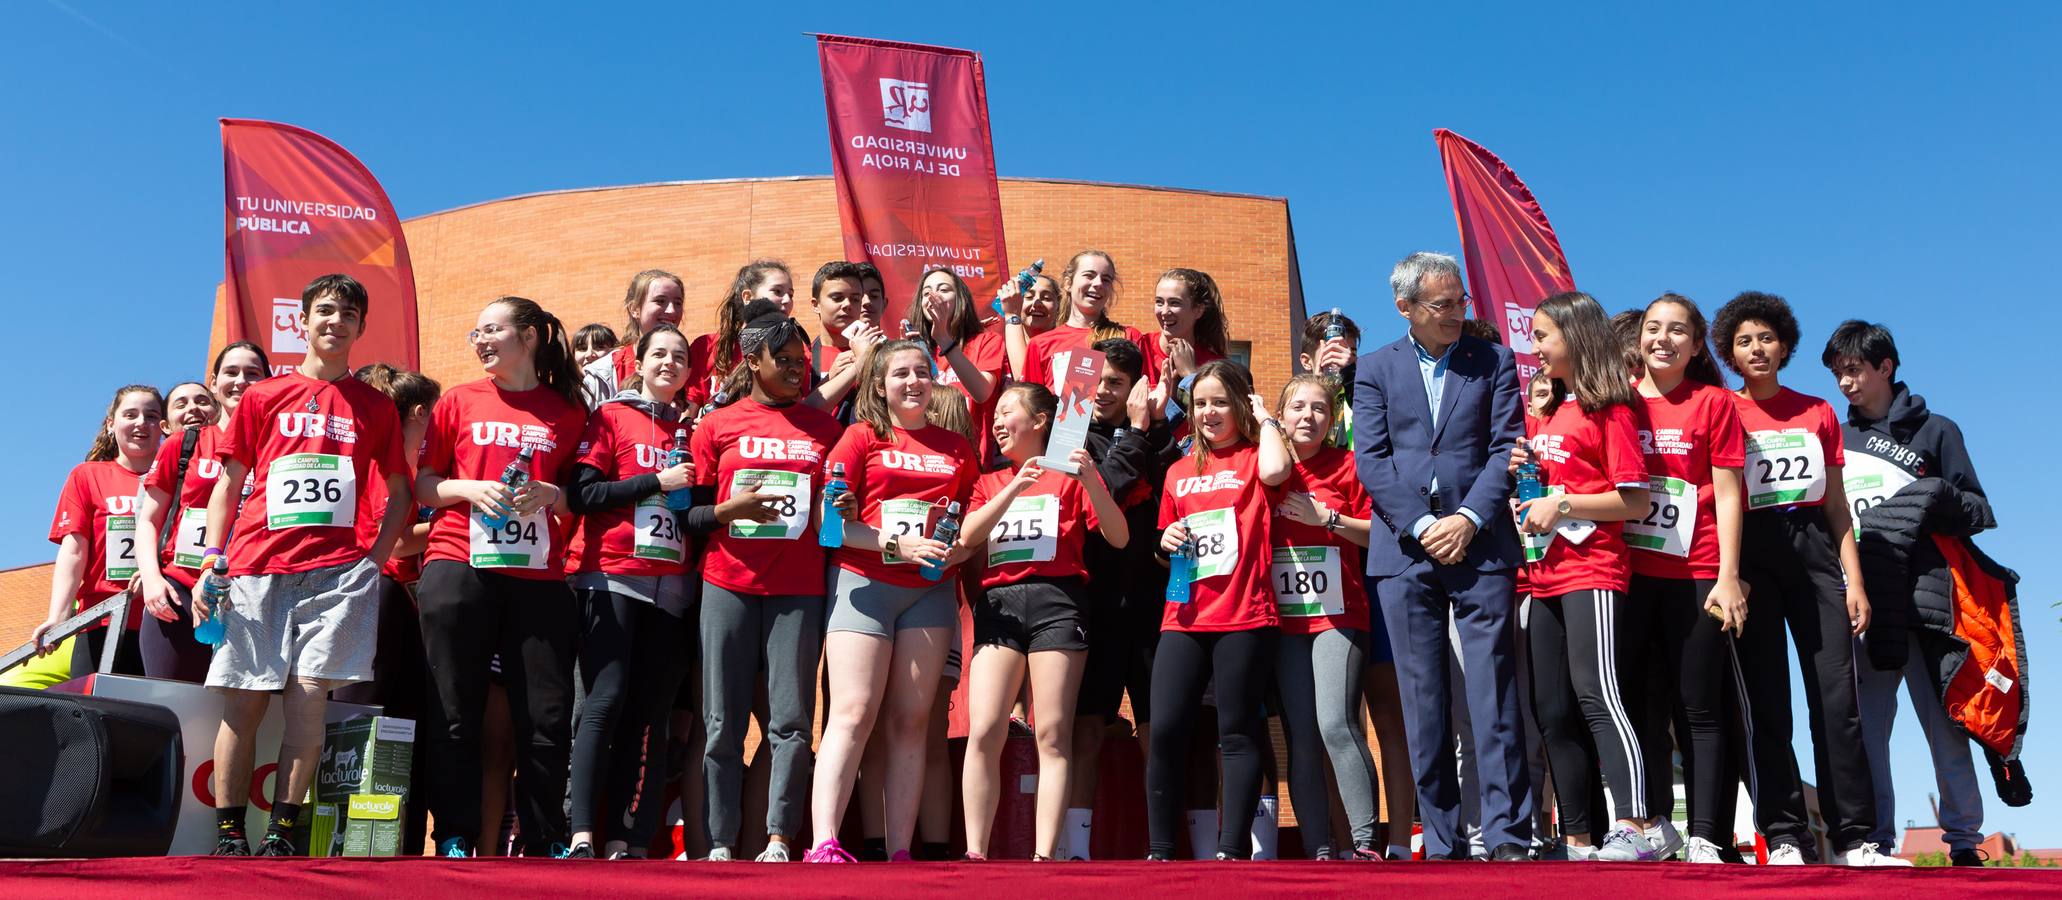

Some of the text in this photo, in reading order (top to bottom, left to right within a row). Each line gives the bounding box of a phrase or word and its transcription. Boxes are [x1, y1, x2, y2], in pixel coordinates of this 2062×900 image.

[237, 197, 376, 220] TU UNIVERSIDAD
[236, 214, 311, 235] PÚBLICA
[278, 412, 326, 437] UR
[472, 421, 520, 448] UR
[1655, 428, 1683, 436] CARRERA
[739, 436, 787, 460] UR
[1655, 441, 1693, 450] UNIVERSIDAD
[1671, 448, 1687, 456] RIOJA
[198, 458, 224, 479] U
[880, 450, 924, 472] UR
[1757, 455, 1812, 484] 222
[283, 478, 341, 504] 236
[1176, 475, 1214, 497] UR
[1625, 501, 1680, 529] 29
[487, 520, 538, 545] 194
[997, 518, 1043, 543] 215
[1196, 533, 1225, 557] 68
[1280, 570, 1328, 594] 180
[321, 766, 369, 785] lacturale
[374, 782, 407, 793] lacturale
[352, 800, 395, 813] lacturale
